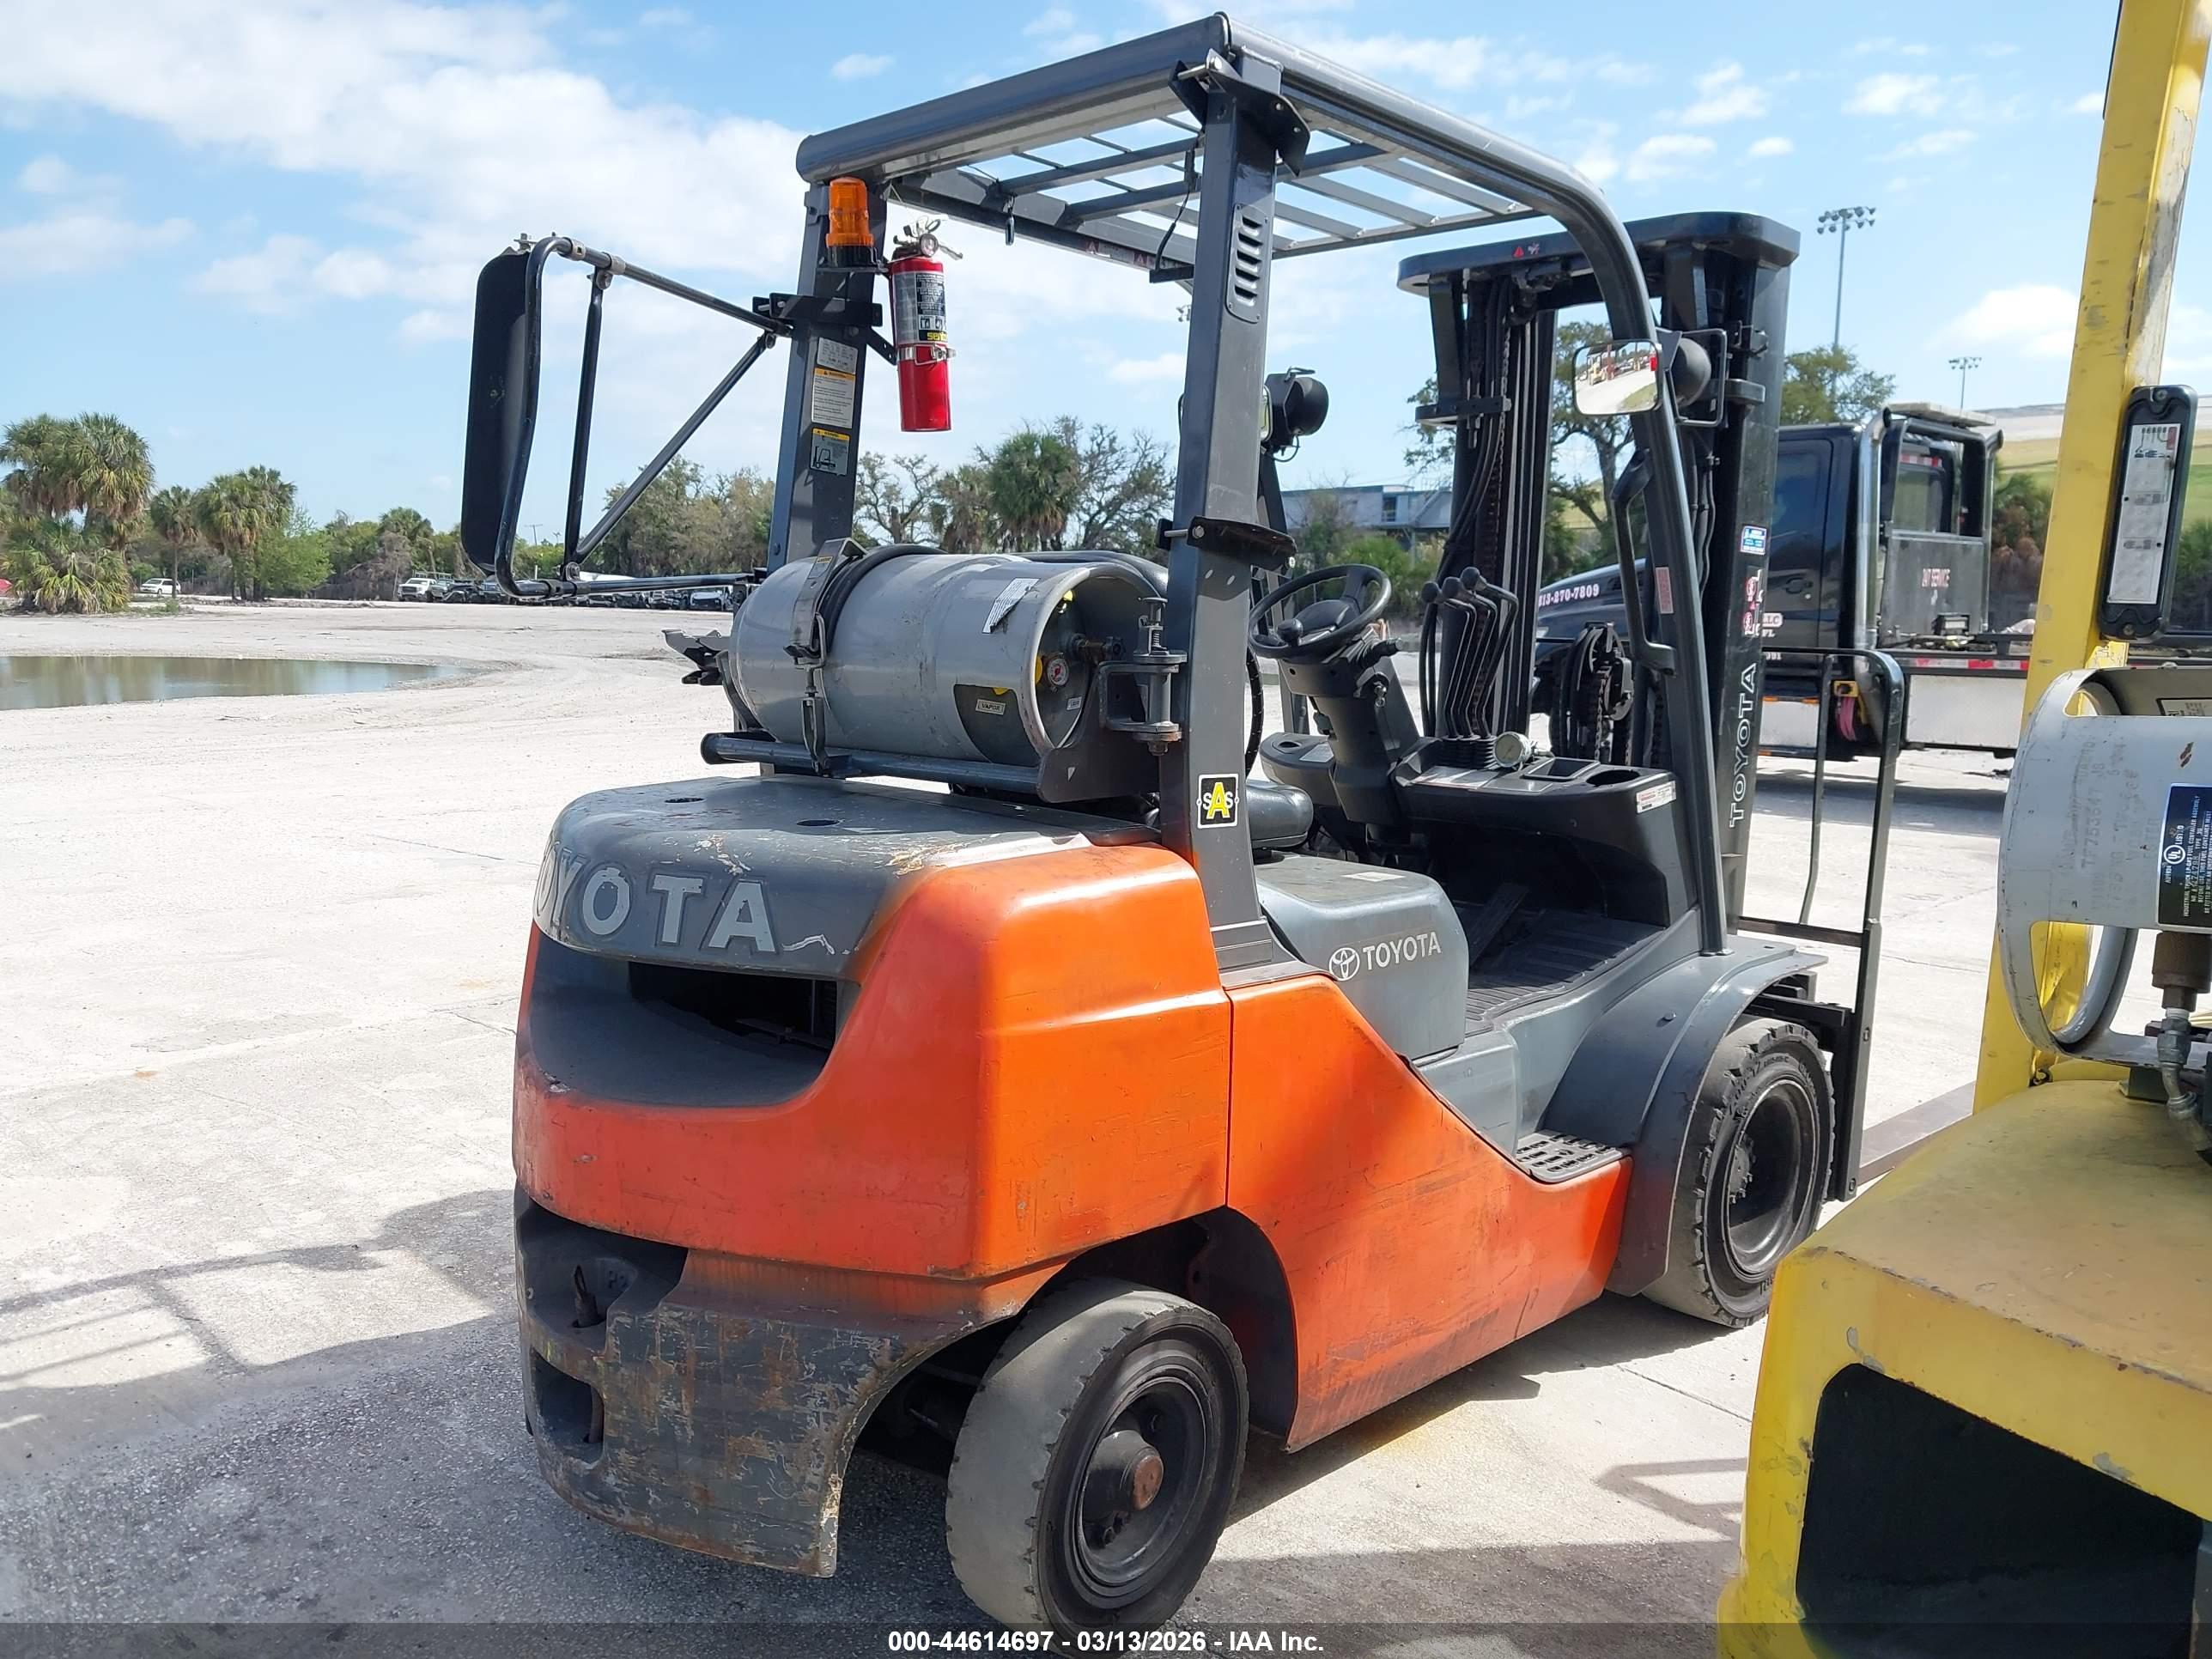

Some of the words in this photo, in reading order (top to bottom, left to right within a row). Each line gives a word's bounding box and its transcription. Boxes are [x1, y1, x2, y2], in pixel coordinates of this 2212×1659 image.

[1729, 663, 1757, 828] TOYOTA
[1202, 781, 1234, 820] SAS
[536, 840, 775, 952] OYOTA
[1363, 932, 1442, 970] TOYOTA
